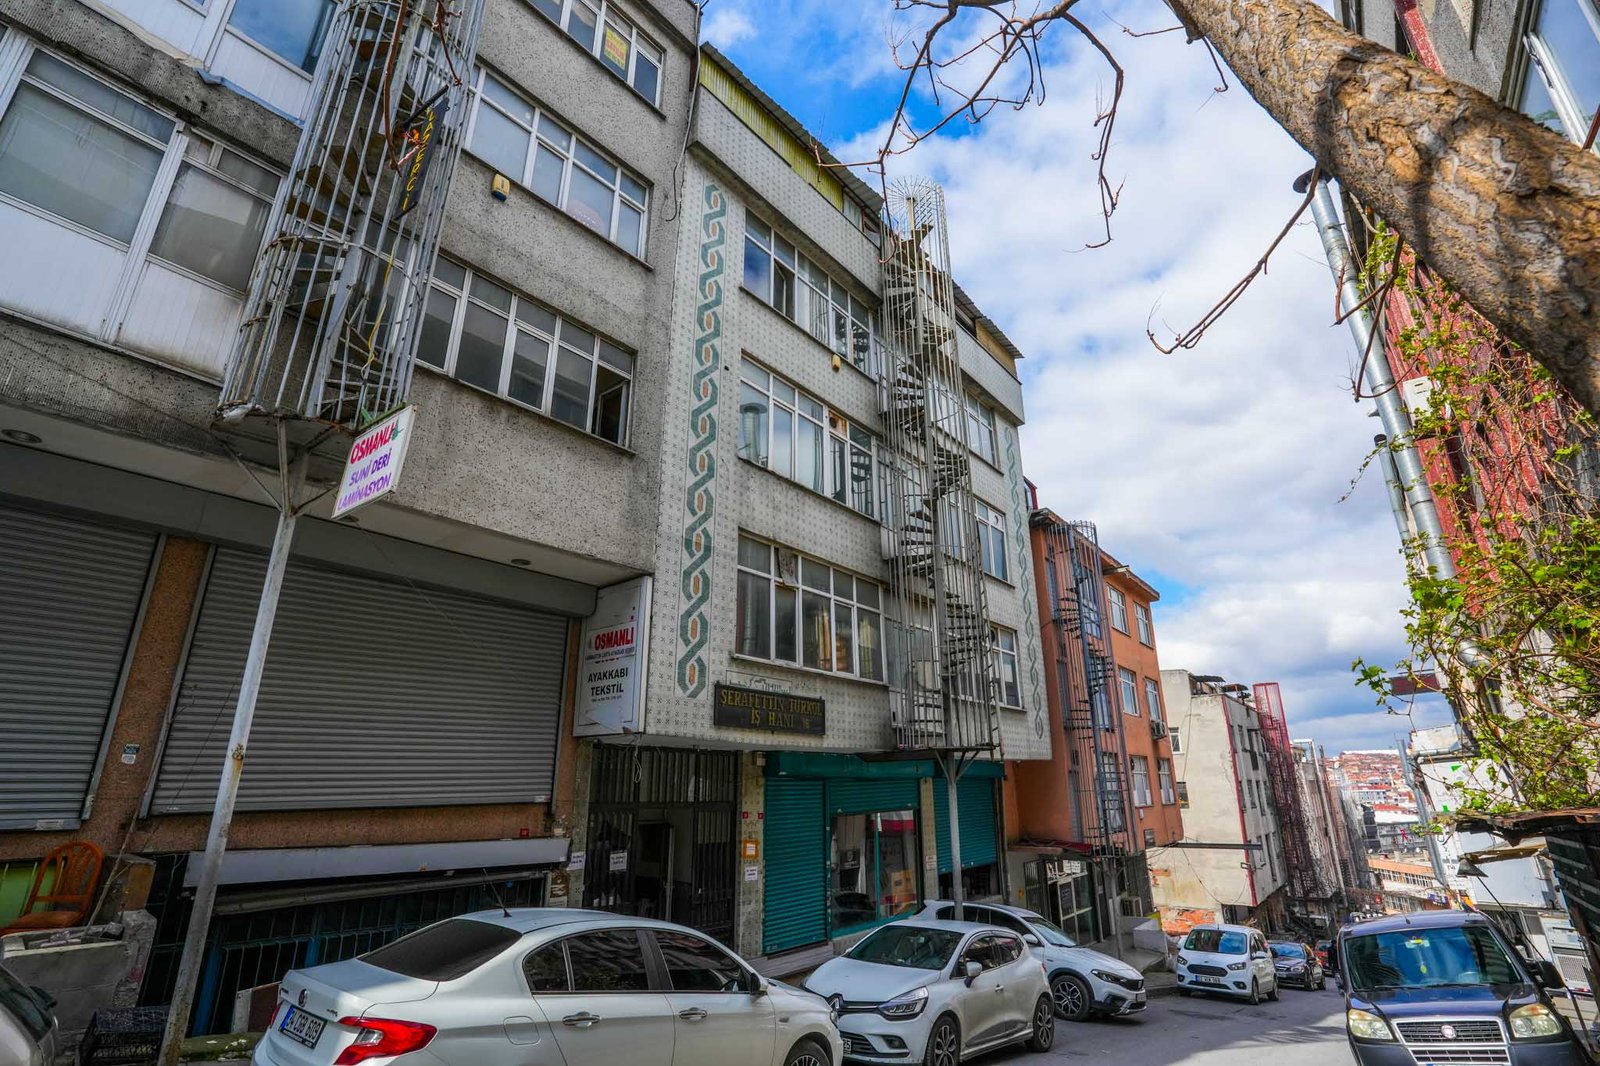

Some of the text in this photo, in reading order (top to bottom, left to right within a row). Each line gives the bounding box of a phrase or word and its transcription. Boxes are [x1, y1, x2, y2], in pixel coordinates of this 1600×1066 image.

[371, 448, 392, 474] DERİ
[338, 472, 392, 510] LAMİNASYON
[594, 627, 635, 651] OSMANLI
[587, 667, 629, 684] AYAKKABI
[590, 680, 624, 697] TEKSTİL
